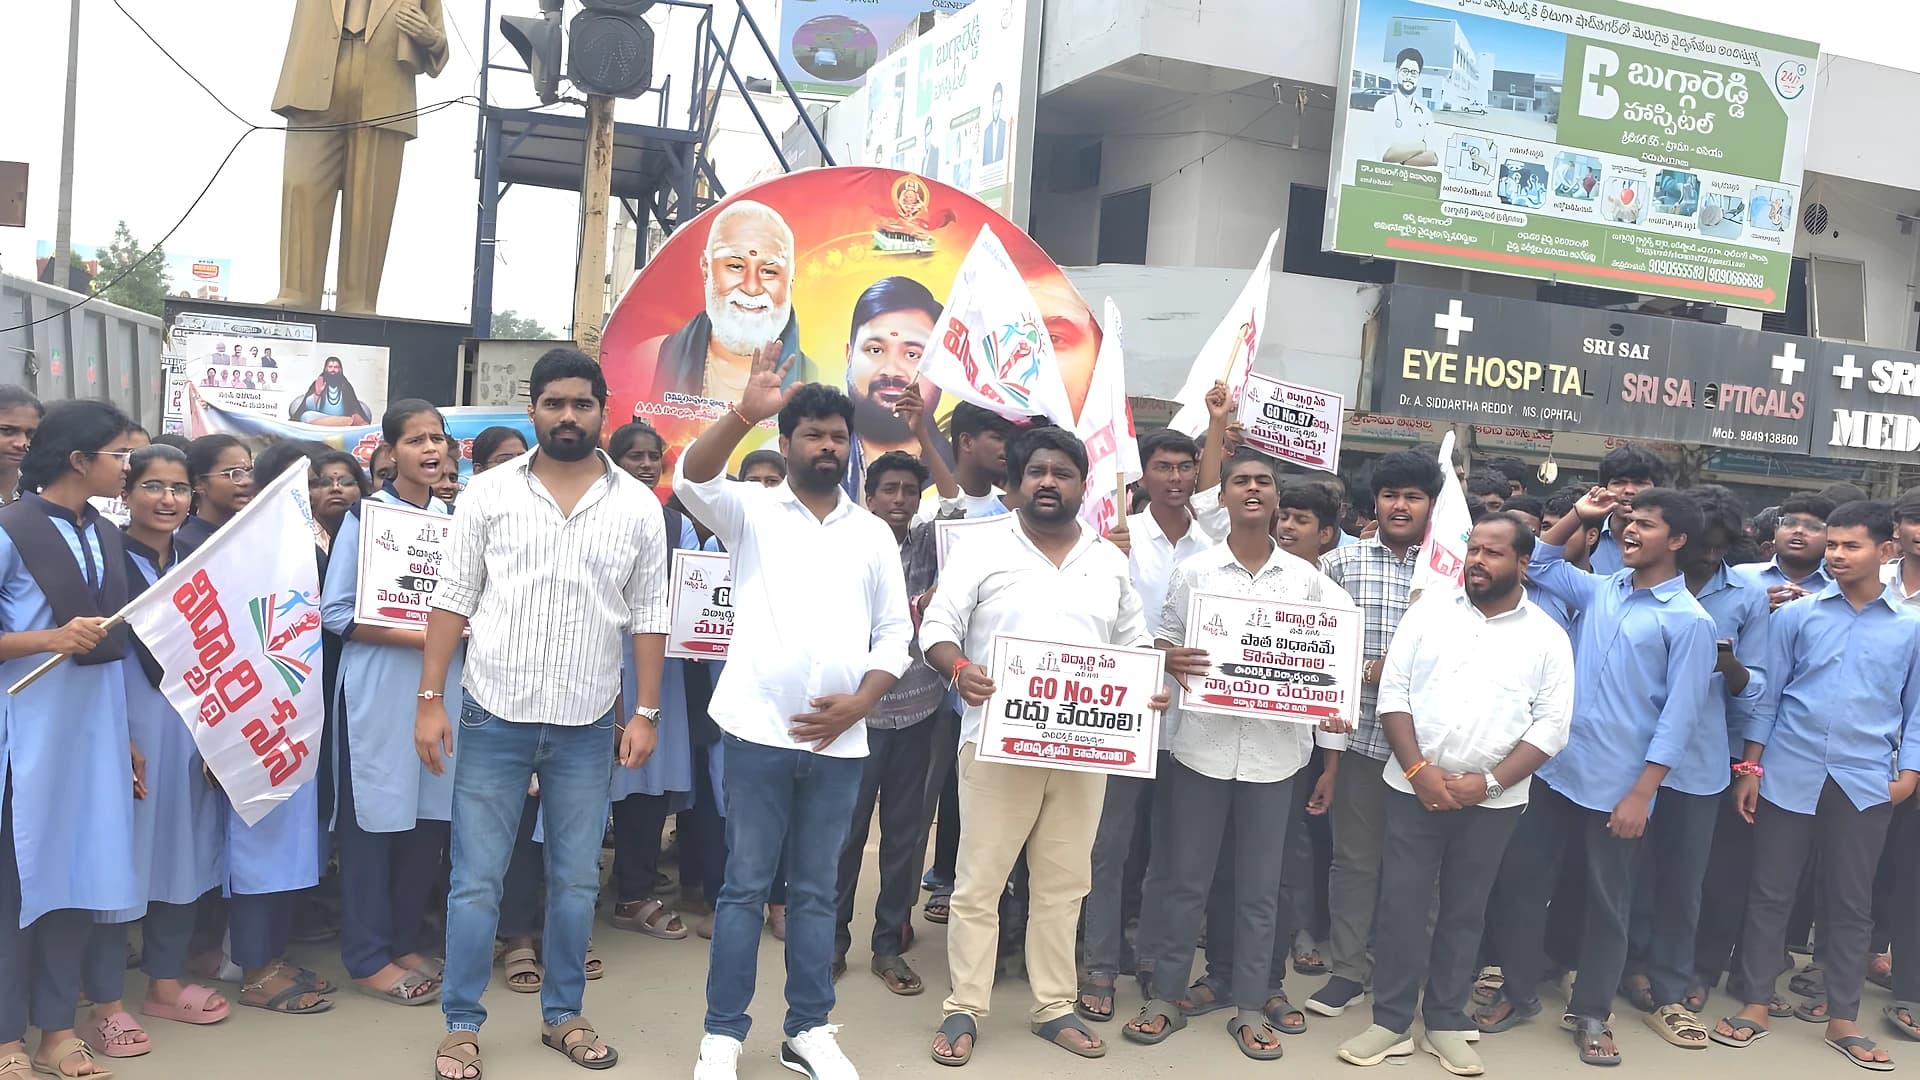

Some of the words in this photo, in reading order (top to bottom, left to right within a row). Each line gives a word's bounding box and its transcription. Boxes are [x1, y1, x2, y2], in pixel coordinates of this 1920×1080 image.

[1628, 62, 1749, 118] బుగ్గారెడ్డి
[1624, 102, 1716, 135] హాస్పిటల్
[1583, 337, 1614, 356] SRI
[1618, 342, 1650, 360] SAI
[1402, 348, 1458, 384] EYE
[1621, 372, 1659, 404] SRI
[1400, 393, 1411, 406] Dr.
[1414, 396, 1423, 407] A.
[1426, 398, 1479, 412] SIDDARTHA
[1266, 404, 1280, 418] GO
[1282, 407, 1312, 427] No.97
[1712, 426, 1737, 440] Mob.
[1740, 429, 1798, 445] 9849138800
[1828, 408, 1920, 452] MED
[409, 562, 439, 577] అట
[377, 588, 421, 605] వెంటనే
[413, 579, 434, 593] GO
[718, 588, 731, 606] G
[1240, 633, 1272, 648] పాత
[1276, 638, 1335, 655] విధానమే
[1242, 649, 1325, 670] కొనసాగాలి
[1029, 676, 1058, 699] GO
[1064, 680, 1128, 707] No.97
[1204, 677, 1270, 696] న్యాయం
[1277, 682, 1345, 704] చేయాలి!
[1004, 699, 1050, 730] రద్దు
[1056, 703, 1142, 732] చేయాలి!
